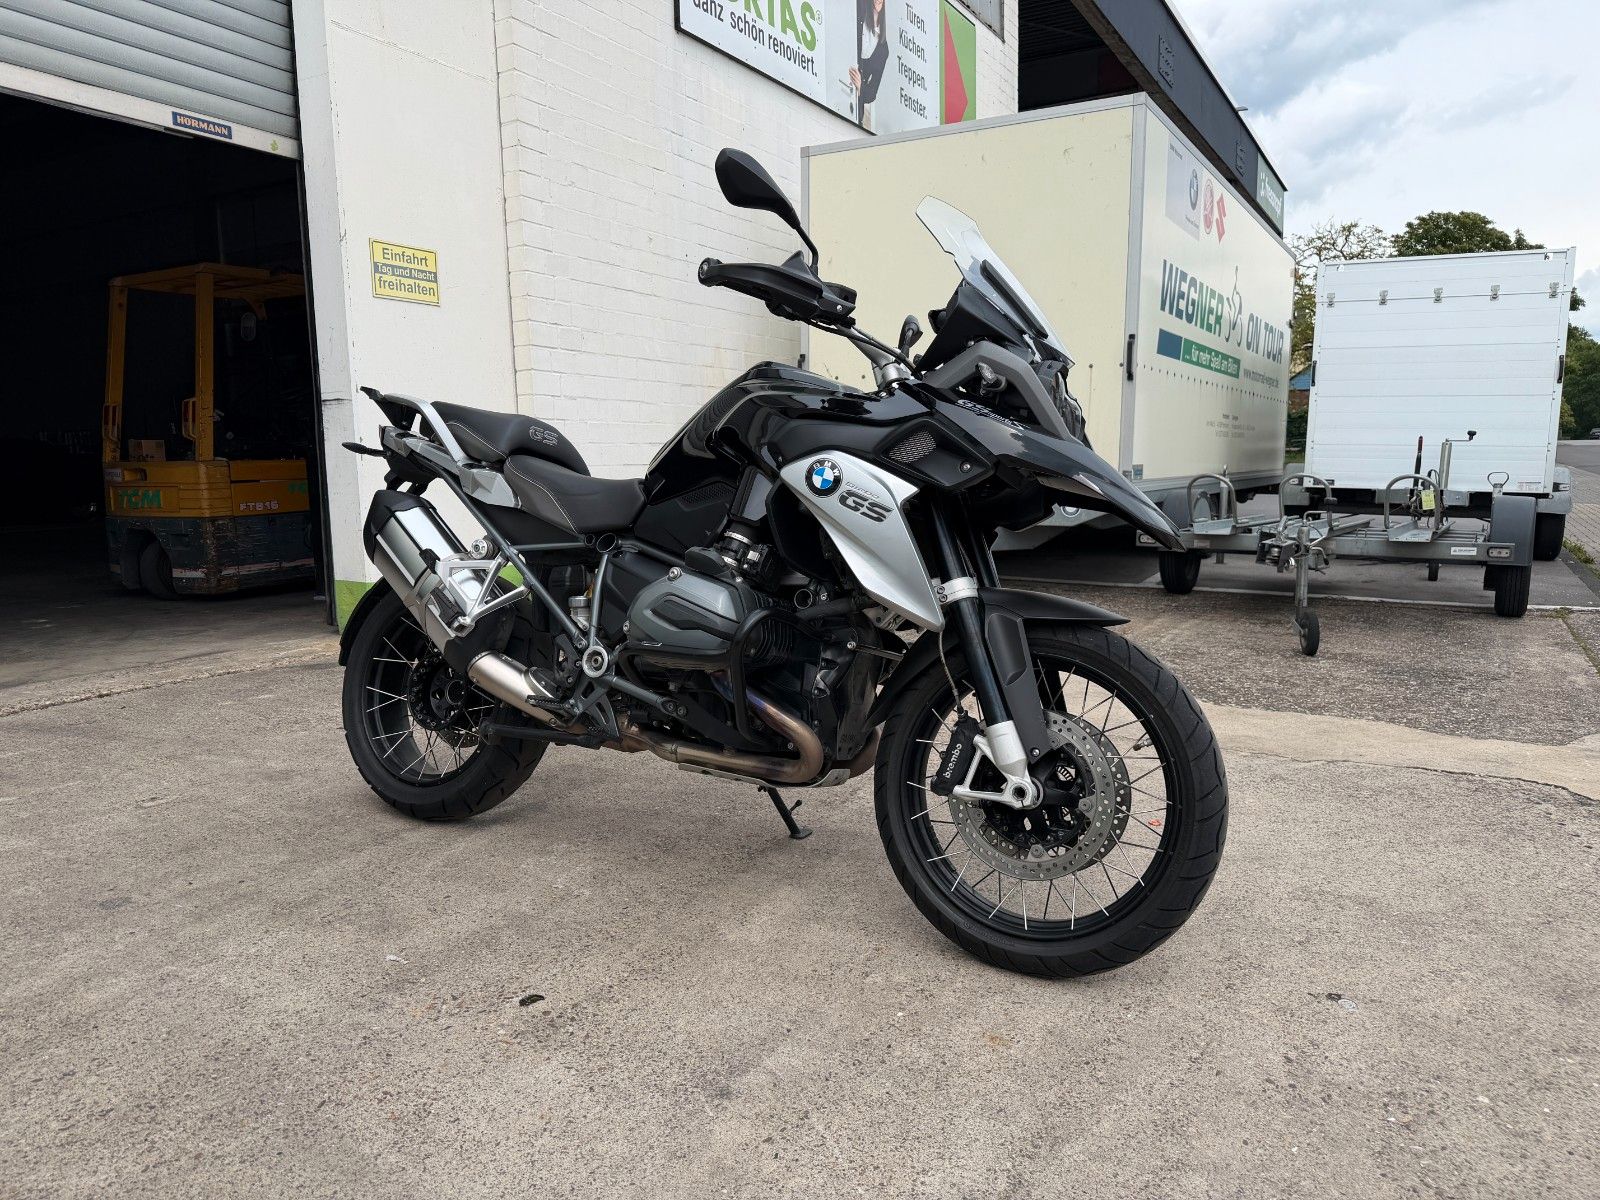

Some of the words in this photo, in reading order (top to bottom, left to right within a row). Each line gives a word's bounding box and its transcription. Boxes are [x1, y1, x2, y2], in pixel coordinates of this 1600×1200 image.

[905, 3, 927, 35] Türen.
[730, 12, 765, 46] schön
[768, 33, 818, 77] renoviert.
[898, 27, 927, 63] Küchen.
[896, 54, 927, 92] Treppen.
[899, 86, 928, 120] Fenster.
[377, 263, 392, 275] Tag
[394, 268, 410, 277] und
[411, 269, 435, 281] Nacht
[382, 247, 429, 267] Einfahrt
[378, 276, 435, 296] freihalten
[1160, 259, 1224, 337] WEGNER
[1246, 313, 1262, 355] ON
[1263, 322, 1285, 364] TOUR
[529, 425, 559, 447] GS
[118, 488, 162, 509] TCM
[838, 489, 895, 523] GS
[942, 743, 963, 779] brembo
